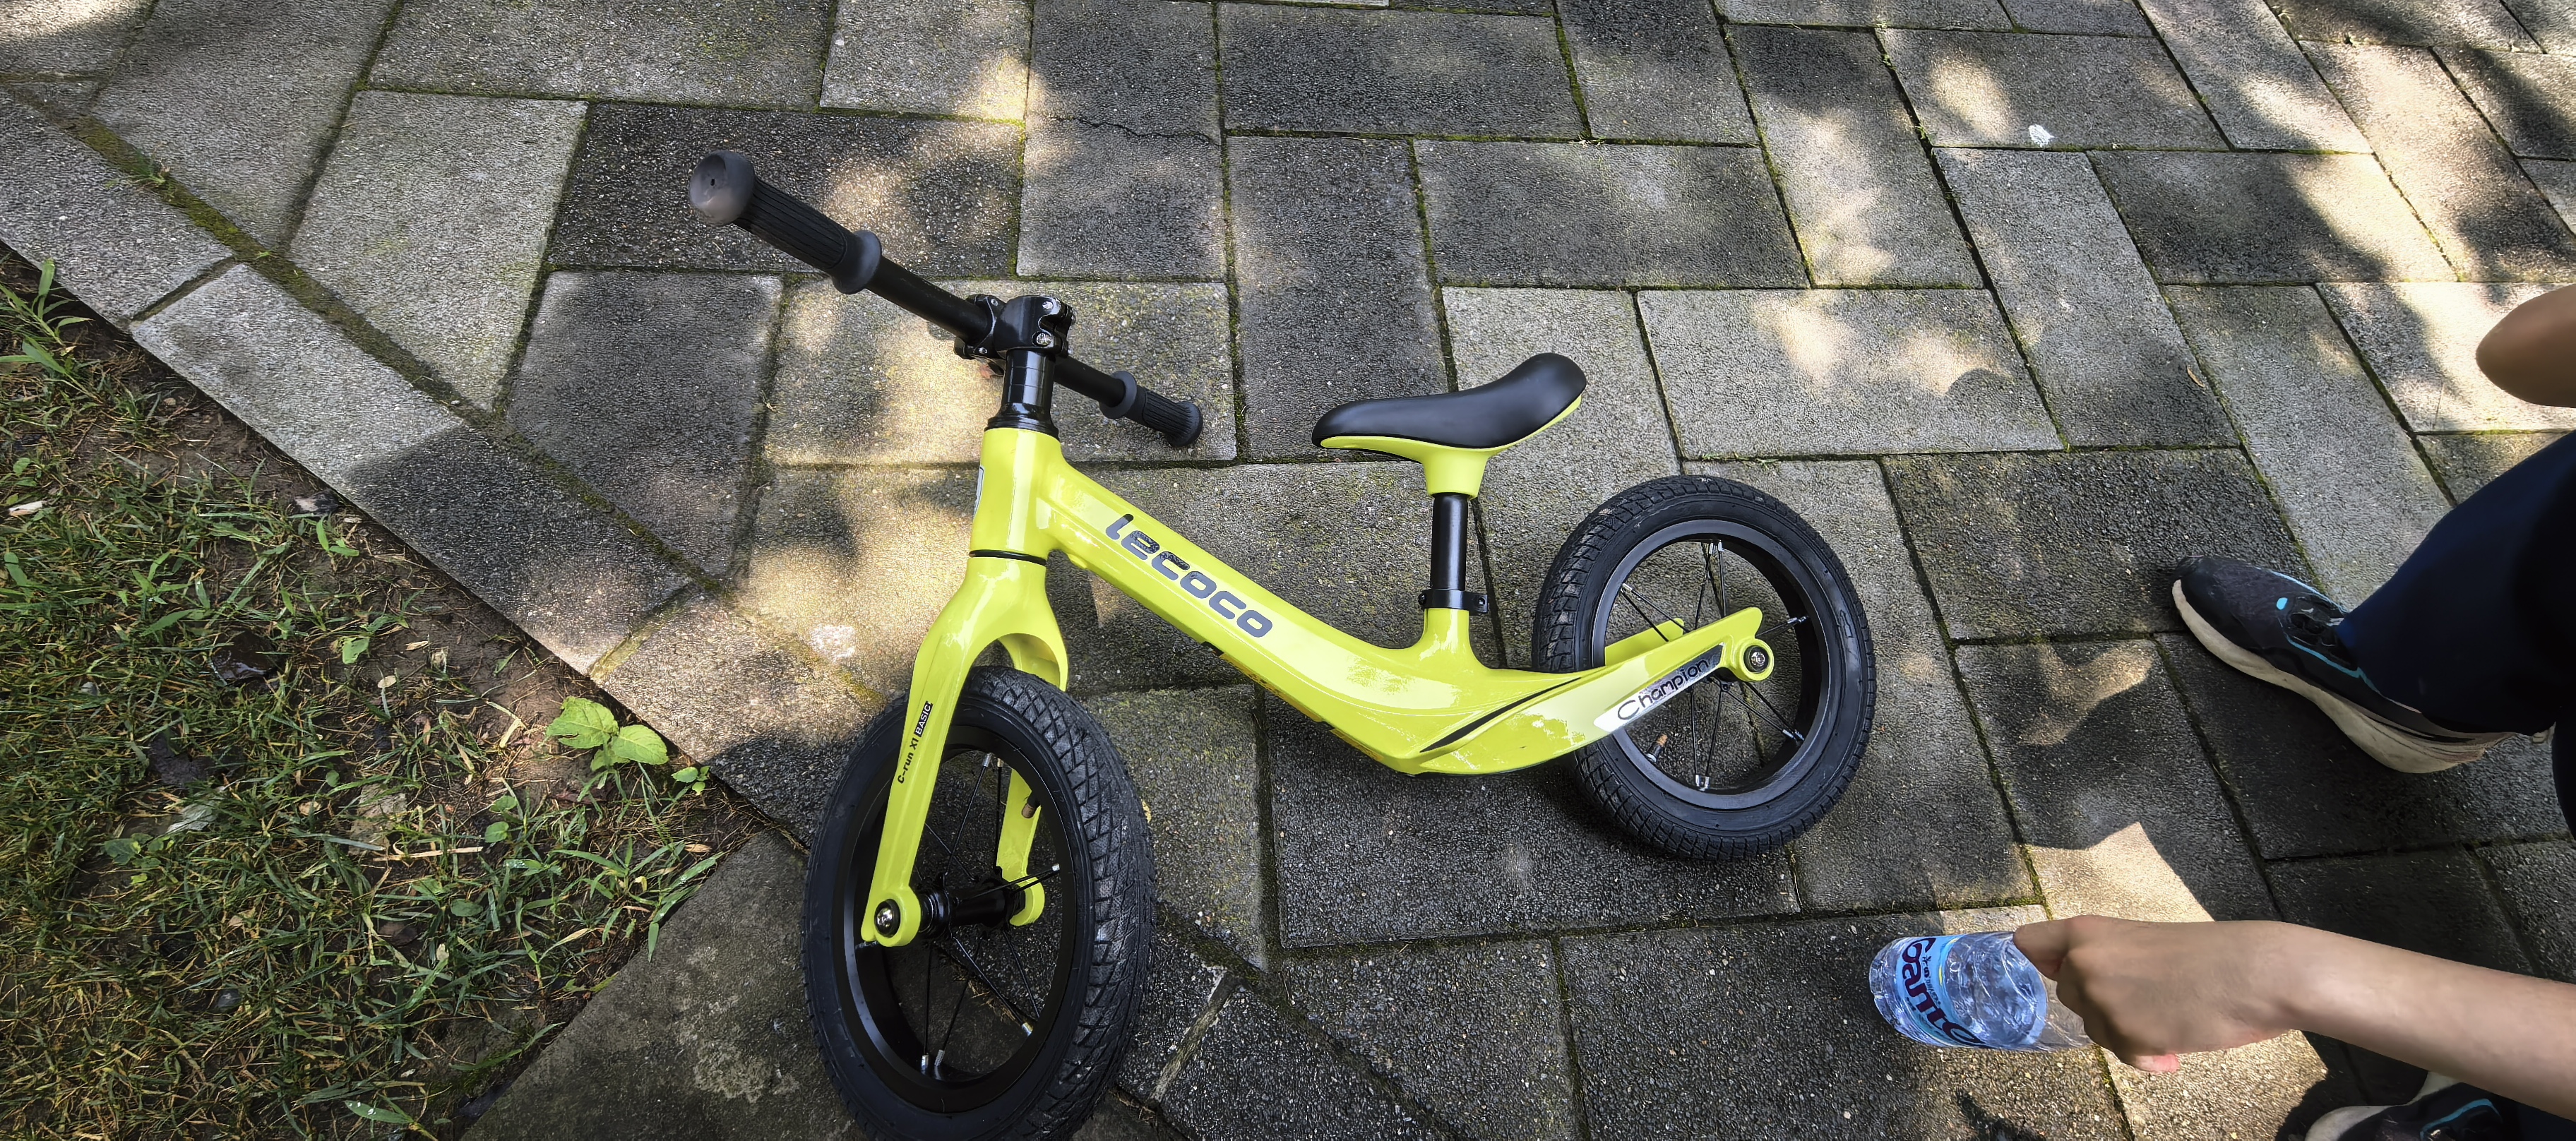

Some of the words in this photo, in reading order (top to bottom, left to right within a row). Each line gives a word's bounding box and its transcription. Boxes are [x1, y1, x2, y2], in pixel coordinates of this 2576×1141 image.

[1106, 513, 1273, 638] lecoco
[1617, 659, 1709, 720] Champion
[898, 752, 914, 784] C-run
[915, 703, 931, 735] BASIC
[1902, 937, 1996, 1049] Gante
